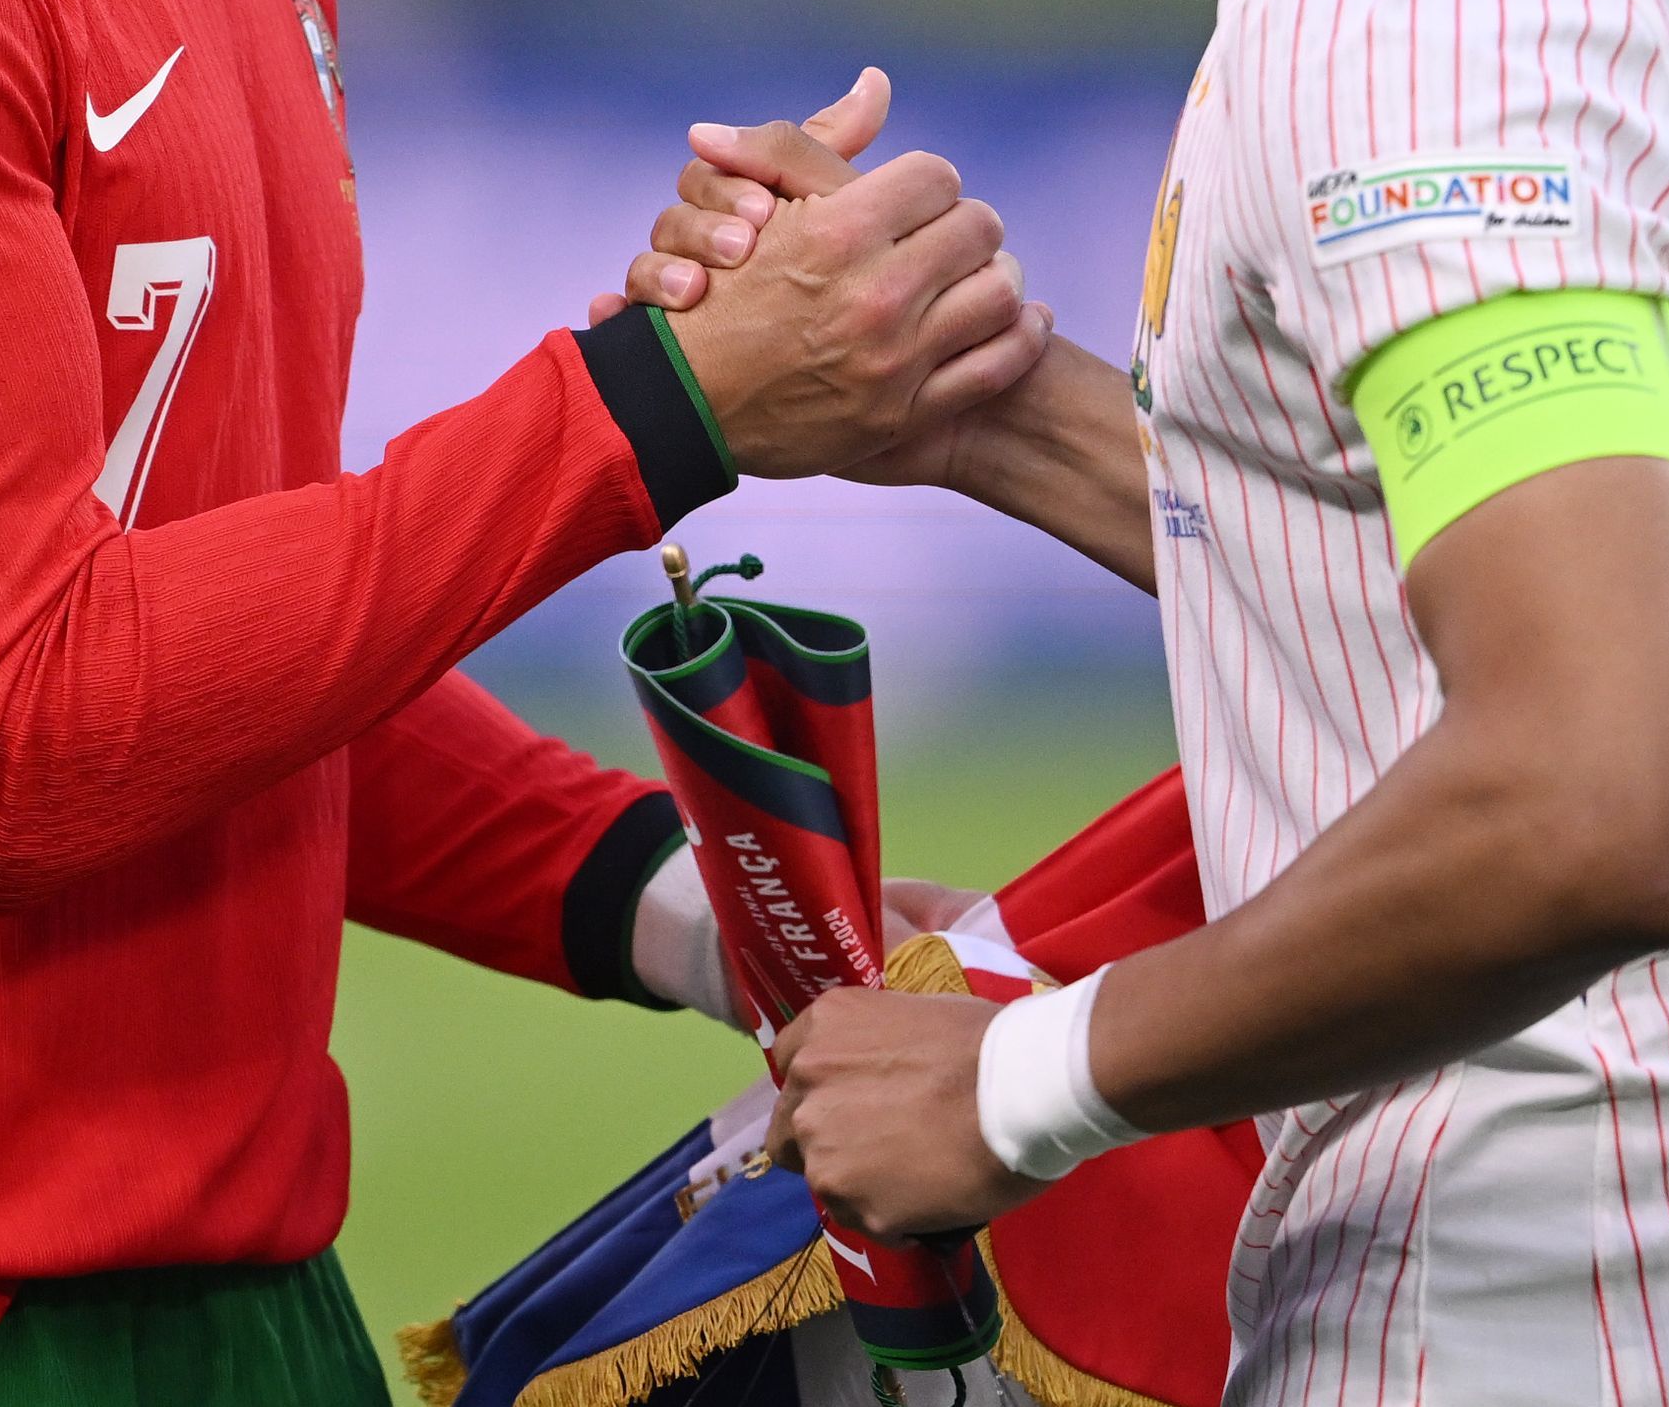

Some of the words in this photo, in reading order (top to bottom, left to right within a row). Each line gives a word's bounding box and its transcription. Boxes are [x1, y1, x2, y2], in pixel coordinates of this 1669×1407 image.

[1311, 175, 1570, 234] FOUNDATION
[93, 236, 216, 534] 7
[1441, 337, 1644, 421] RESPECT
[725, 832, 828, 960] FRANÇA
